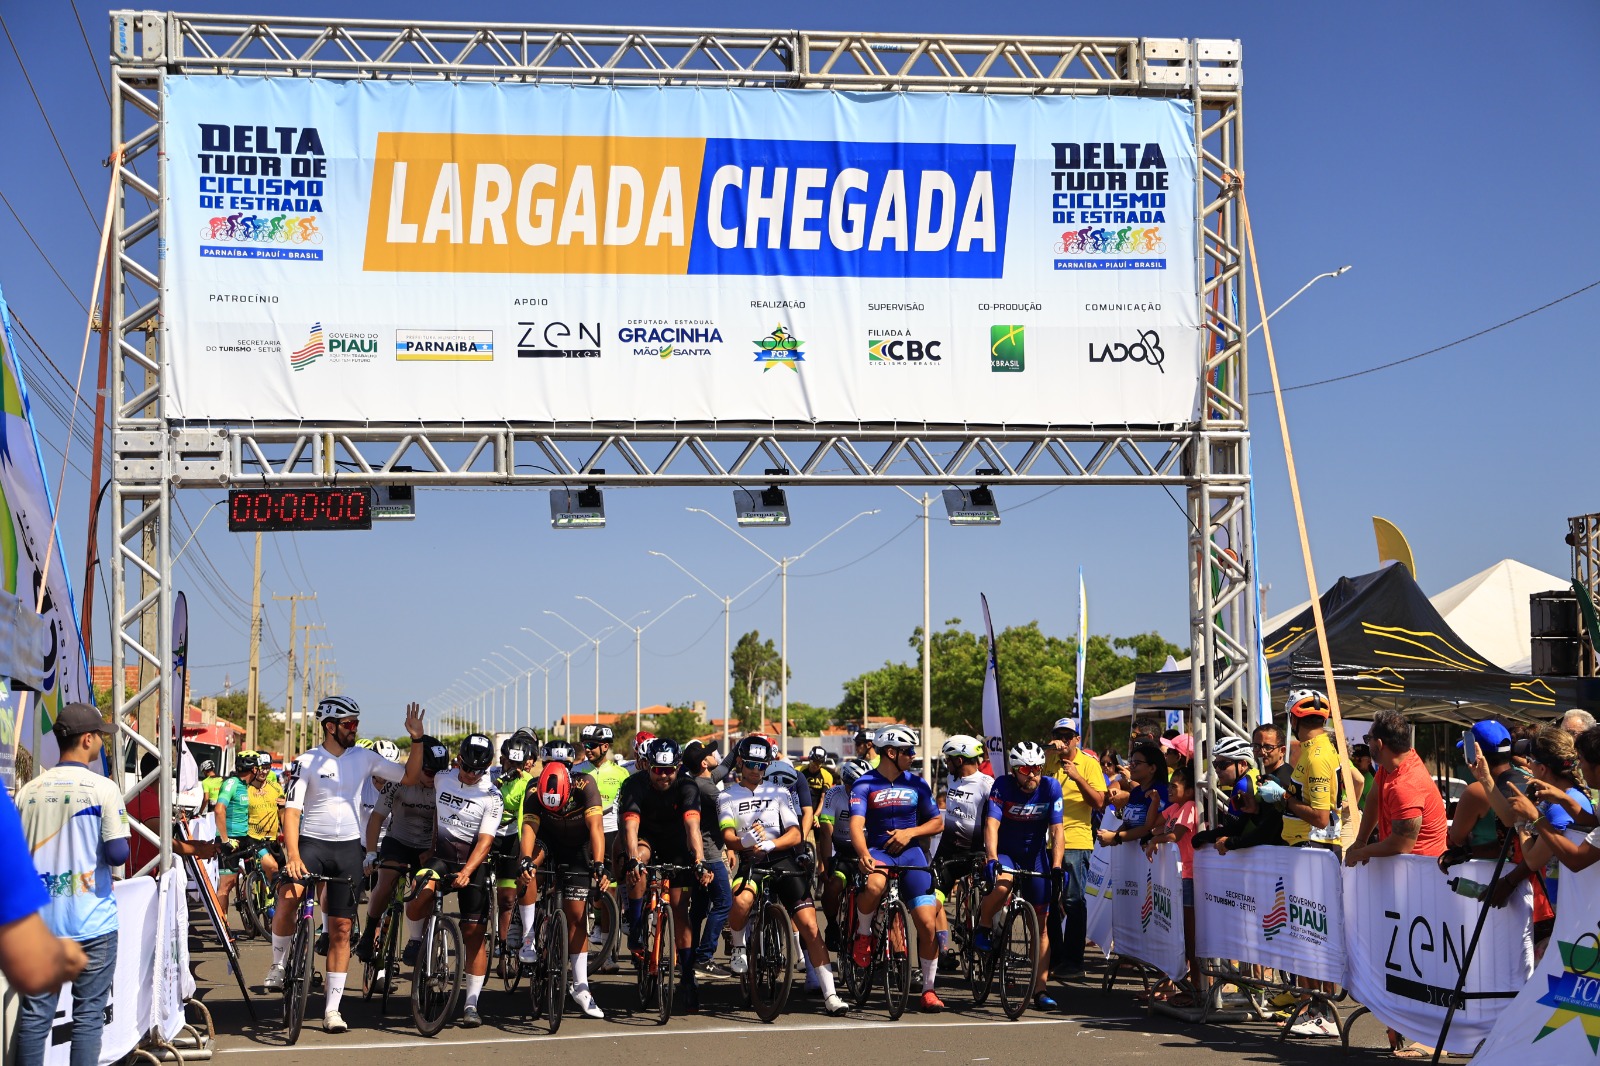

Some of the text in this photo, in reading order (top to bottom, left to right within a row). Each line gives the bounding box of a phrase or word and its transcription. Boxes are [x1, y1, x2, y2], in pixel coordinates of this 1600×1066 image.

[198, 123, 325, 156] DELTA
[1051, 143, 1167, 169] DELTA
[197, 154, 327, 178] TUOR DE
[200, 176, 324, 197] CICLISMO
[1051, 172, 1169, 191] TUOR DE
[200, 195, 323, 212] DE ESTRADA
[1053, 193, 1165, 209] CICLISMO
[386, 161, 996, 253] LARGADA CHEGADA
[1053, 211, 1165, 223] DE ESTRADA
[204, 248, 319, 259] PARNAÍBA PIAUÍ BRASIL
[1057, 261, 1097, 269] PARNAÍBA
[1106, 261, 1127, 269] PIAUÍ
[209, 293, 279, 304] PATROCÍNIO
[514, 298, 548, 306] APOIO
[750, 300, 806, 309] REALIZAÇÃO
[868, 302, 925, 311] SUPERVISÃO
[978, 301, 1042, 312] CO-PRODUÇÃO
[1085, 302, 1162, 312] COMUNICAÇÃO
[618, 327, 723, 343] GRACINHA
[868, 329, 903, 337] FILIADA
[329, 339, 378, 353] PIAUÍ
[633, 346, 711, 356] MÃO SANTA
[888, 340, 941, 361] CBC
[770, 350, 789, 358] FCP
[233, 491, 365, 522] 00:00:00
[325, 704, 333, 714] 3
[887, 732, 895, 741] 12
[961, 744, 967, 753] 2
[662, 754, 667, 762] 6
[773, 775, 778, 784] 8
[948, 788, 973, 799] BRT
[439, 792, 477, 809] BRT
[546, 796, 556, 805] 10
[739, 800, 772, 811] BRT
[1213, 895, 1236, 908] TURISMO
[1225, 890, 1256, 904] SECRETARIA
[1288, 894, 1327, 913] GOVERNO DO
[1289, 903, 1328, 936] PIAUÍ
